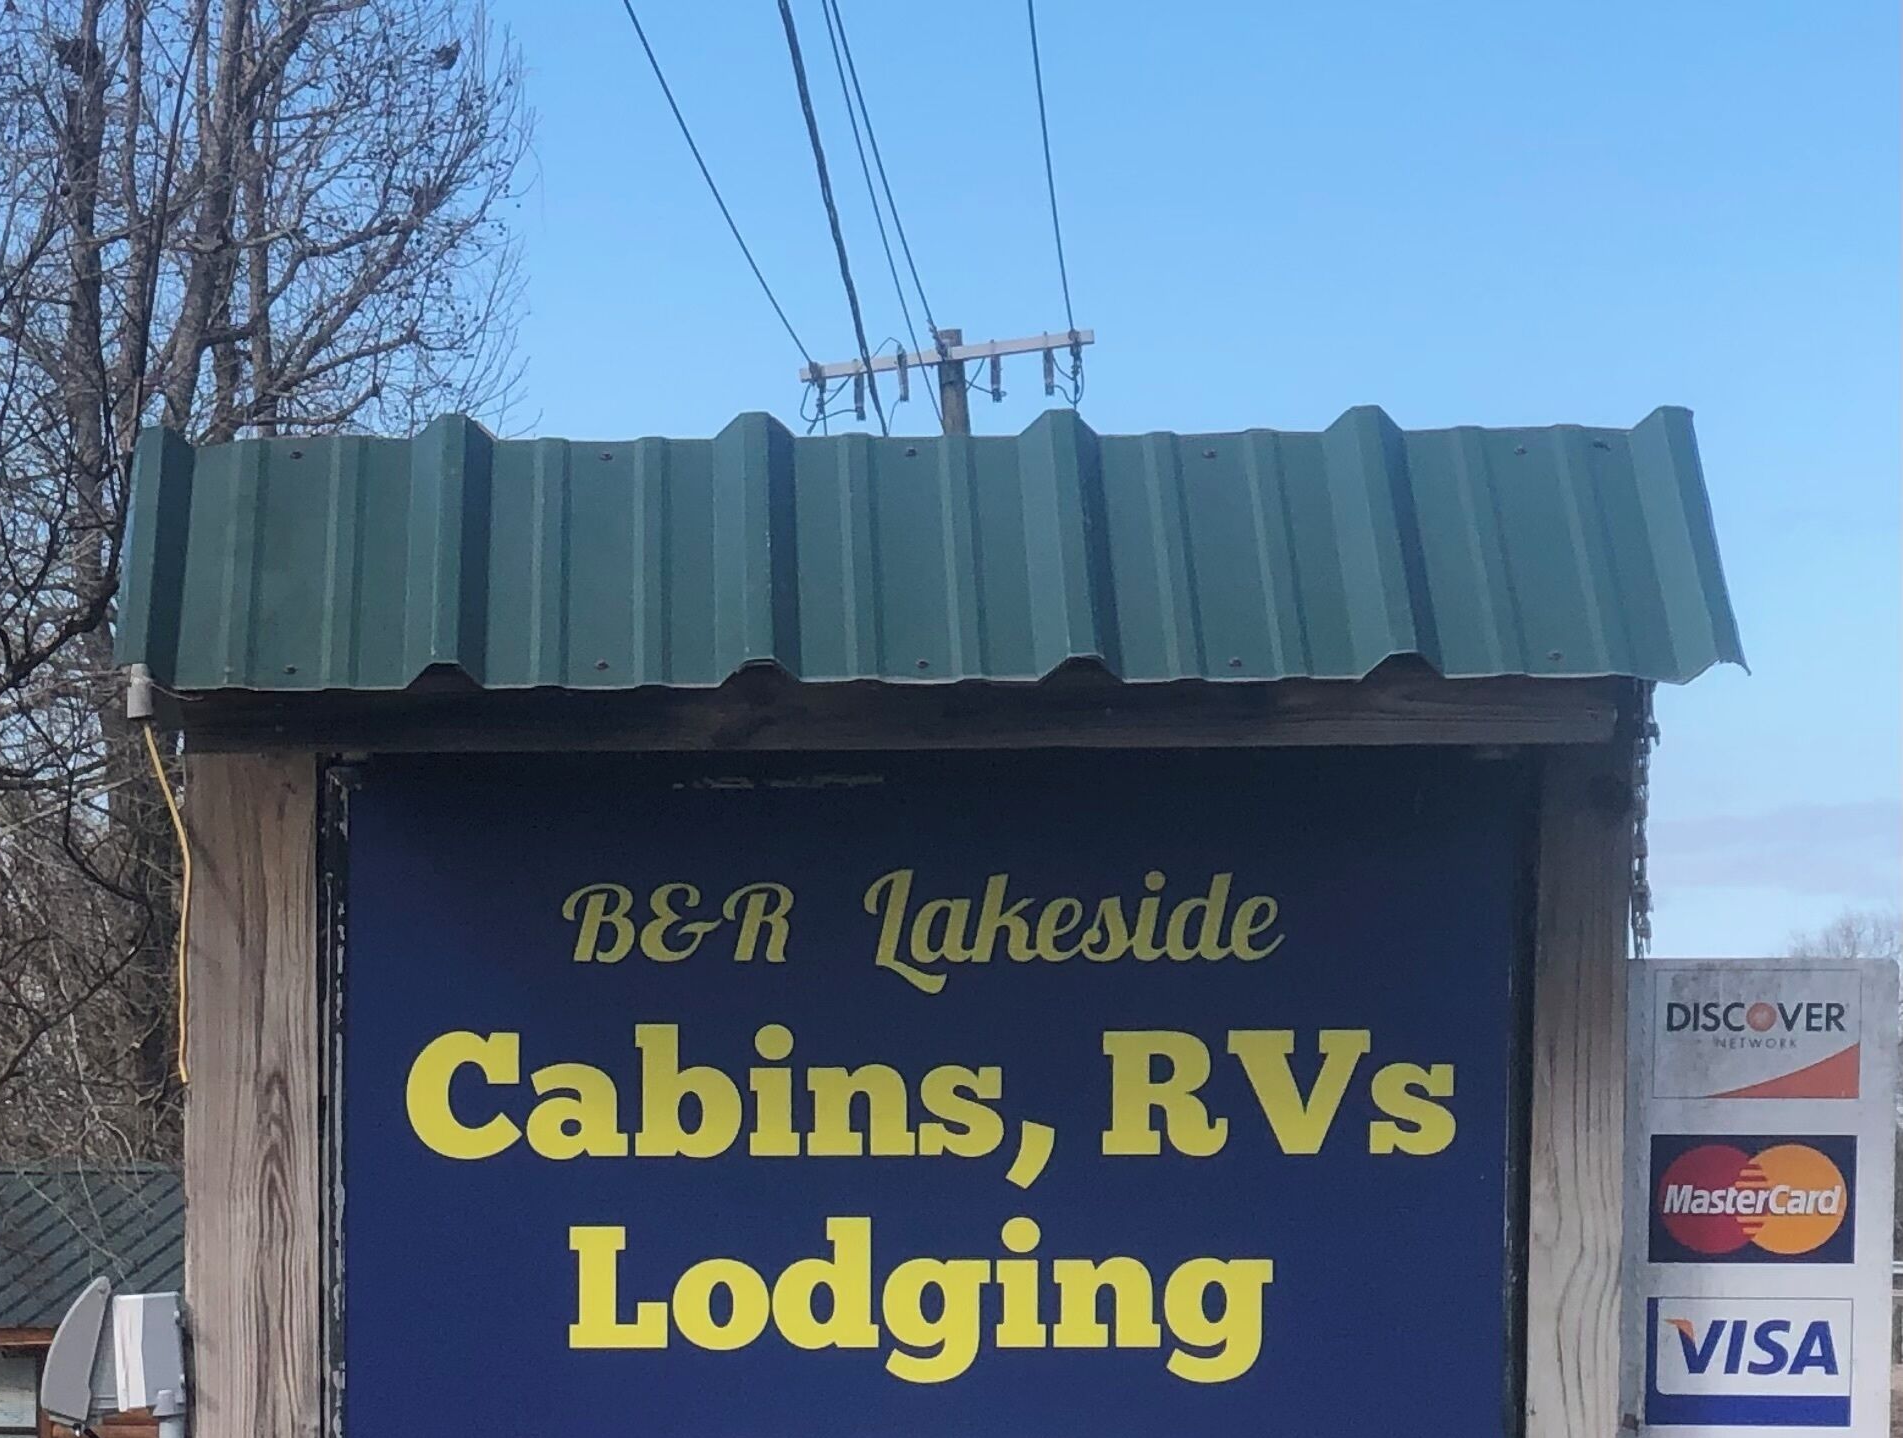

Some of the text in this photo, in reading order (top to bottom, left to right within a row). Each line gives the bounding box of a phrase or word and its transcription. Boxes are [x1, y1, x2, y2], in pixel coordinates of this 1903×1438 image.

[562, 869, 1284, 993] B&R Lakeside
[1666, 1002, 1846, 1034] DISCOVER
[1714, 1037, 1796, 1049] NETWORK
[406, 1024, 1456, 1188] Cabins, RVs
[1663, 1184, 1841, 1215] MasterCard
[569, 1217, 1273, 1383] Lodging
[1665, 1318, 1839, 1375] VISA
